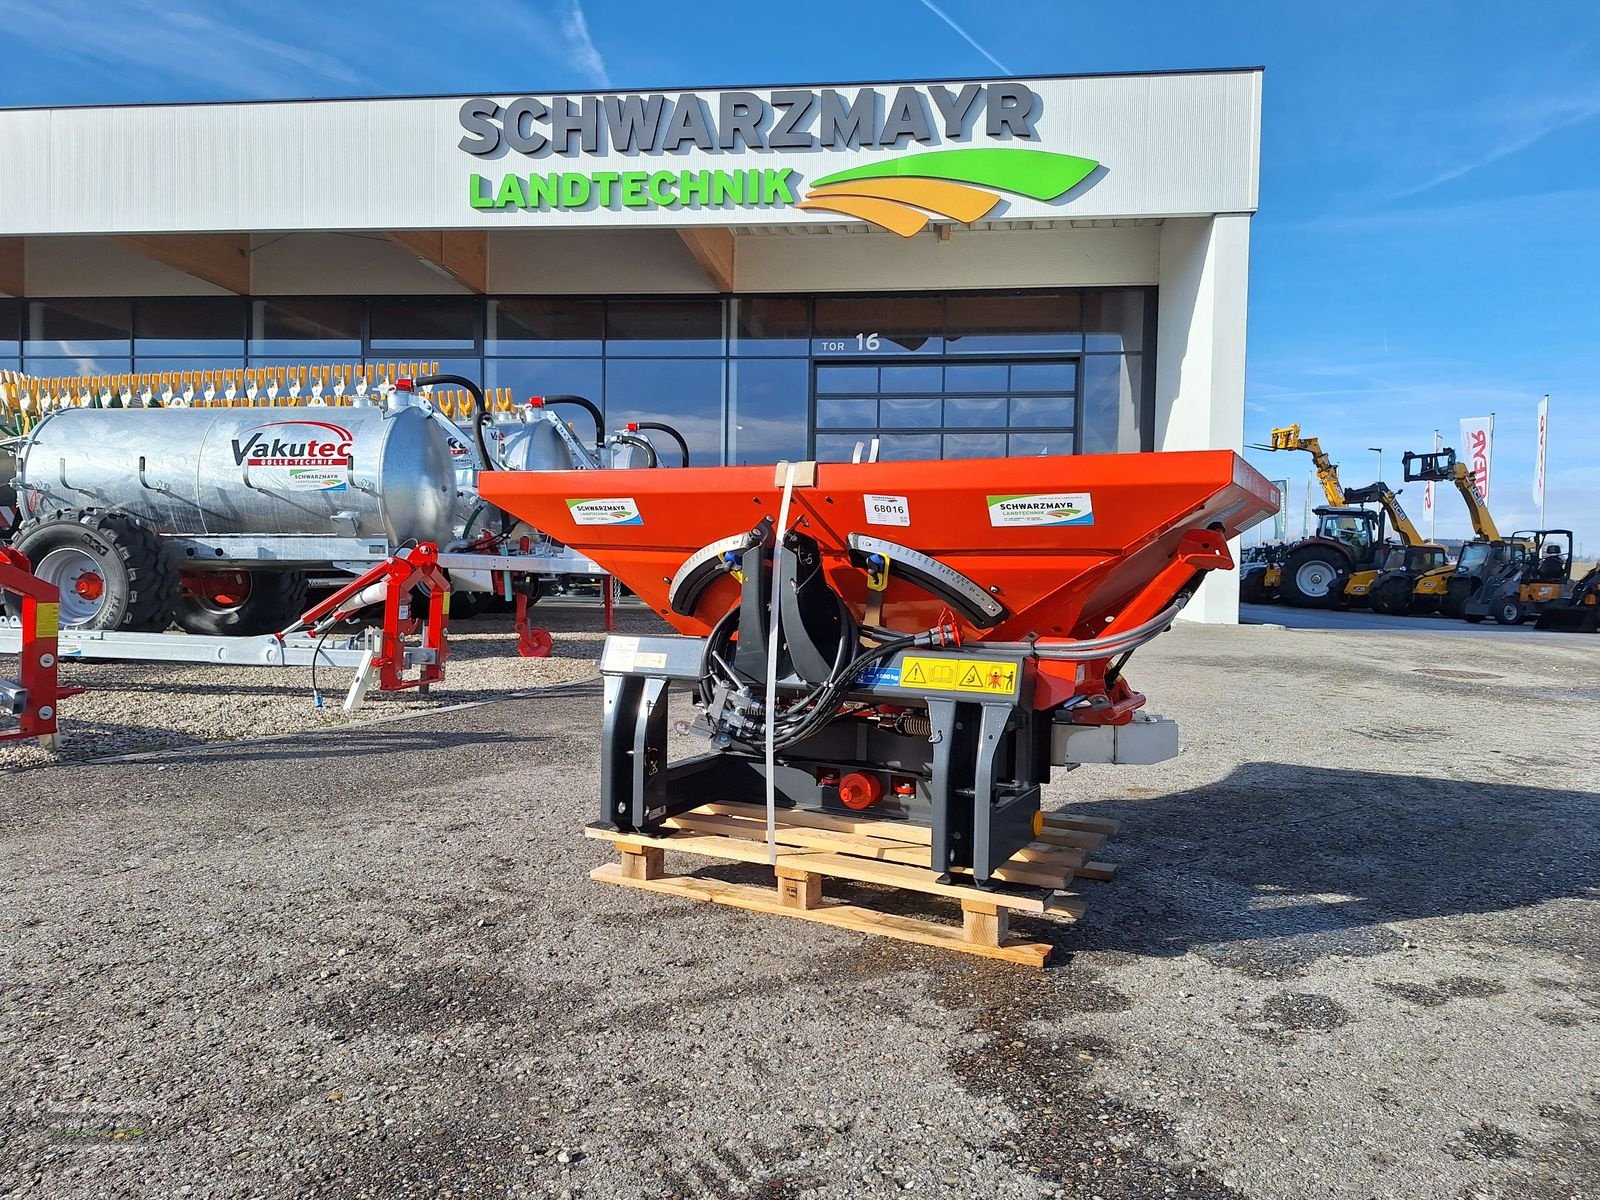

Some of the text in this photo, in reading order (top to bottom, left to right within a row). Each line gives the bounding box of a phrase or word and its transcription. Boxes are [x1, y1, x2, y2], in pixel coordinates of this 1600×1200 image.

[457, 83, 1033, 155] SCHWARZMAYR
[470, 168, 795, 209] LANDTECHNIK
[822, 333, 880, 351] TOR 16
[231, 432, 353, 466] Vakutec
[874, 504, 904, 514] 68016
[1000, 502, 1073, 511] SCHWARZMAYR
[1392, 501, 1406, 520] JCB
